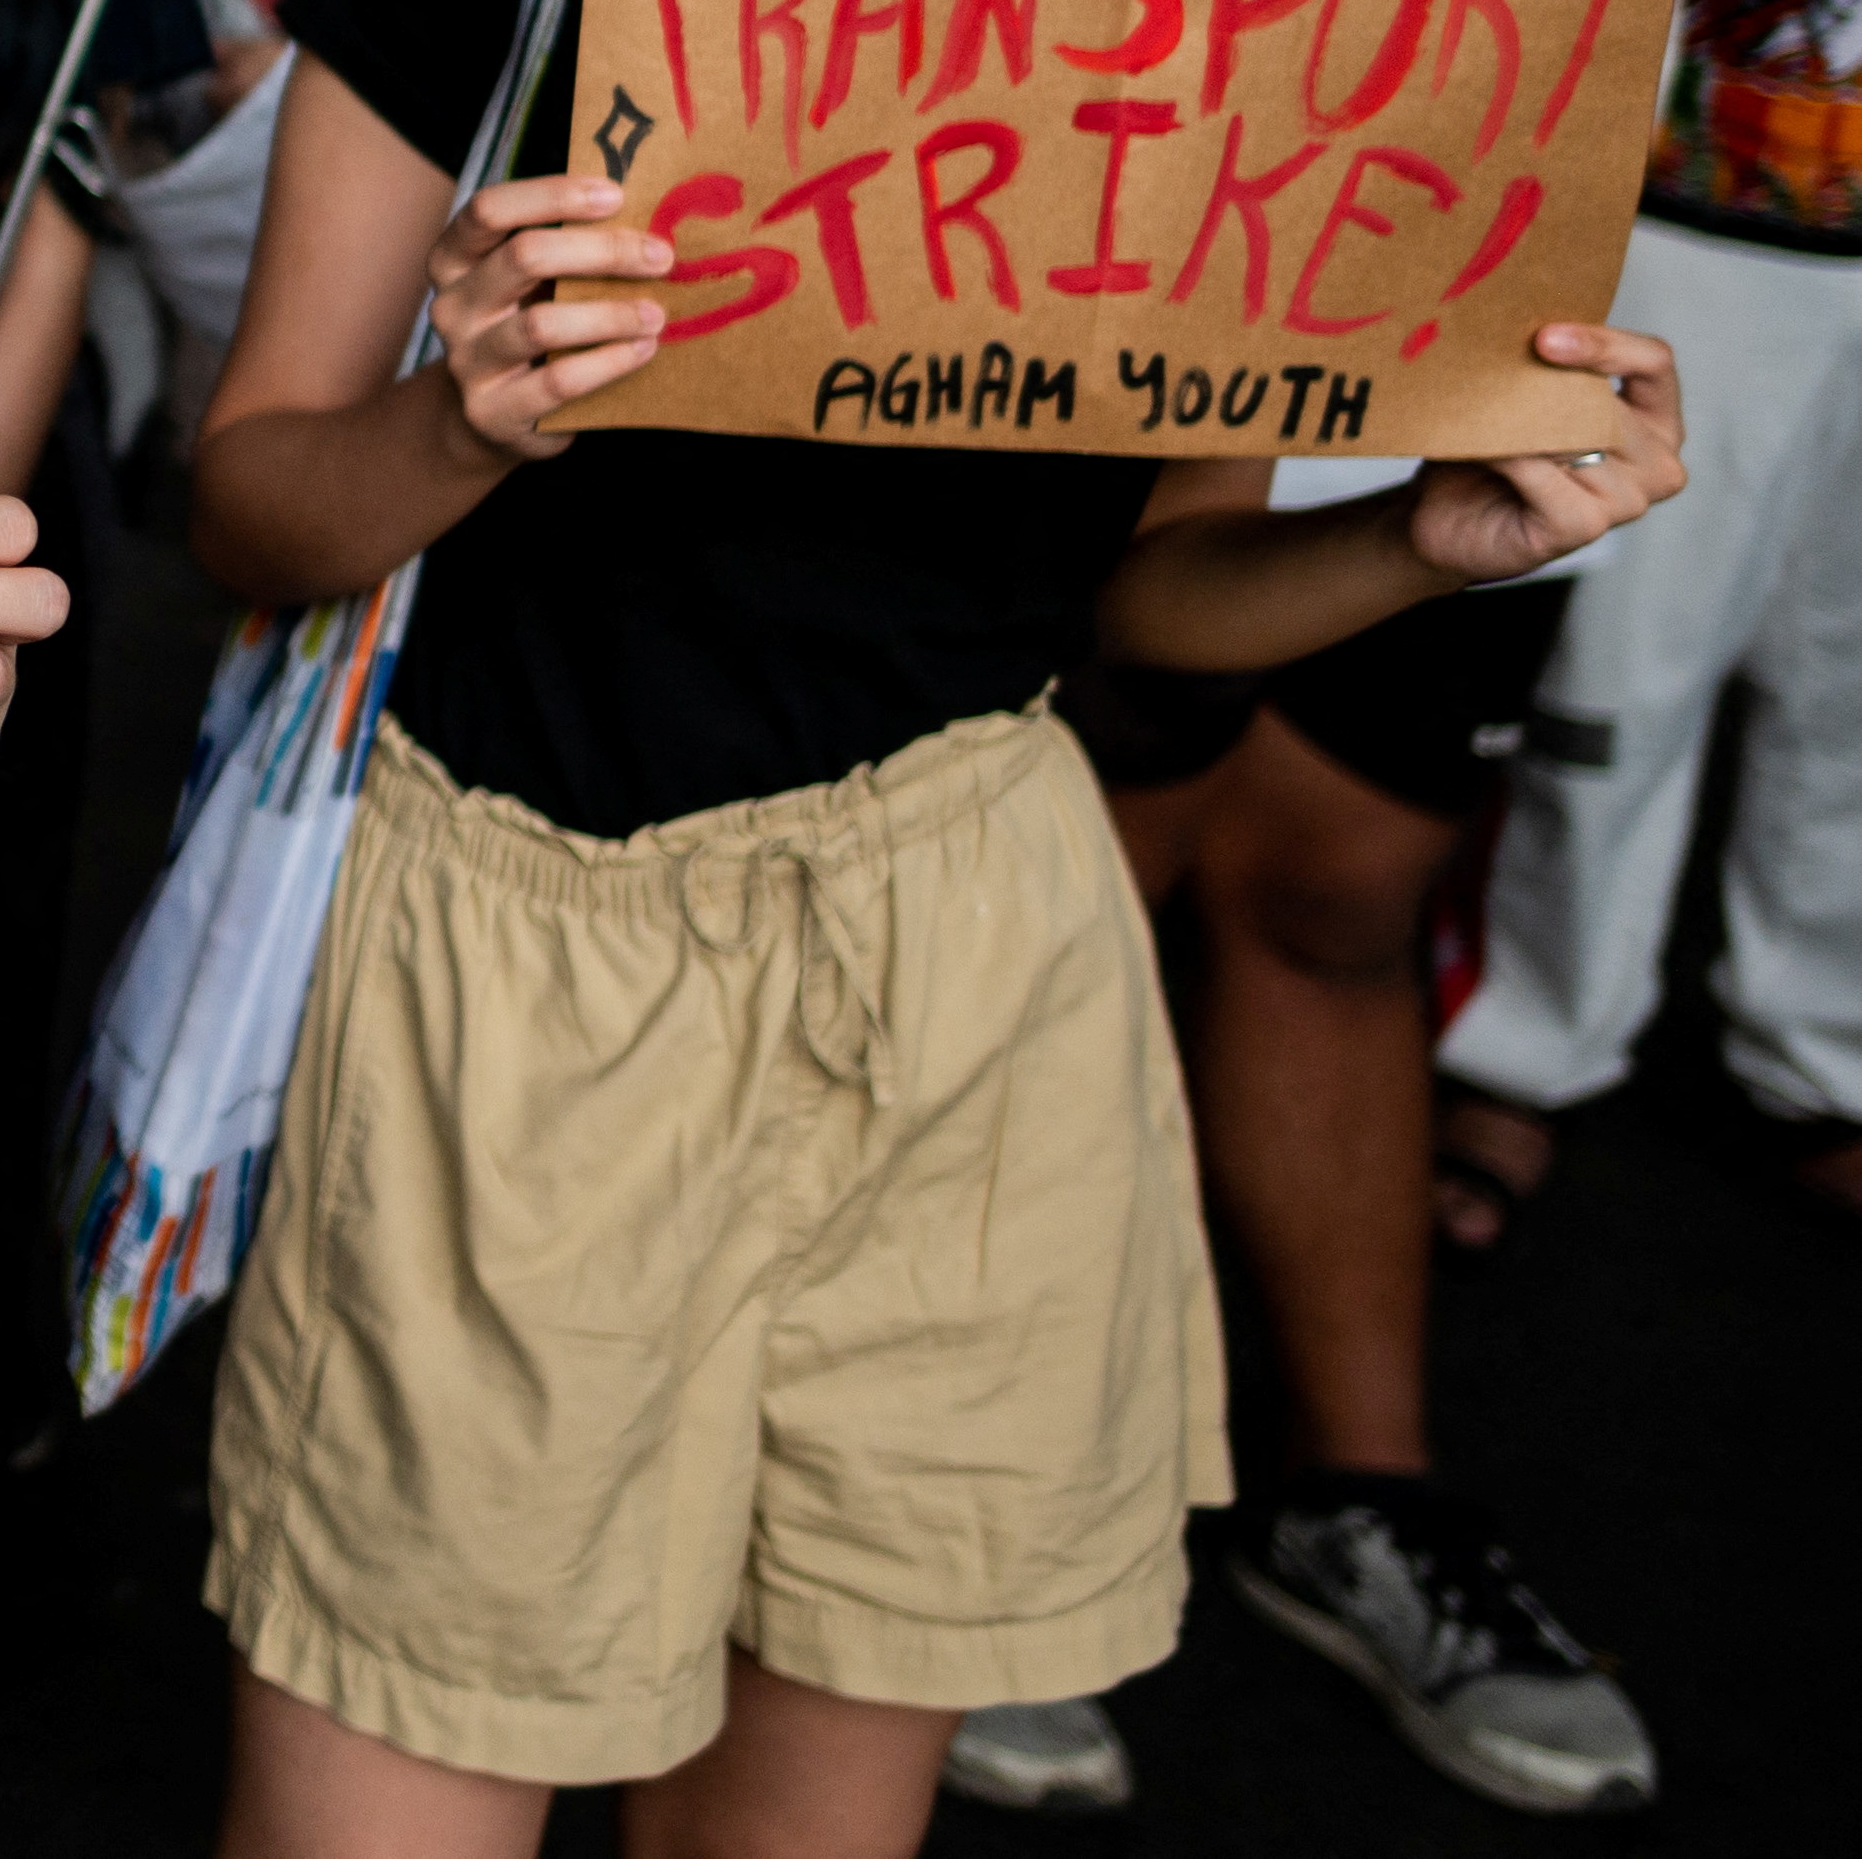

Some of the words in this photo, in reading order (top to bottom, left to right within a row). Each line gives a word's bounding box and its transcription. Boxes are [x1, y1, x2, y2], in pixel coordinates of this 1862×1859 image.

[648, 100, 1546, 363] STRIKE!
[814, 343, 1078, 433] AGHAM
[1118, 349, 1374, 443] YOUTH
